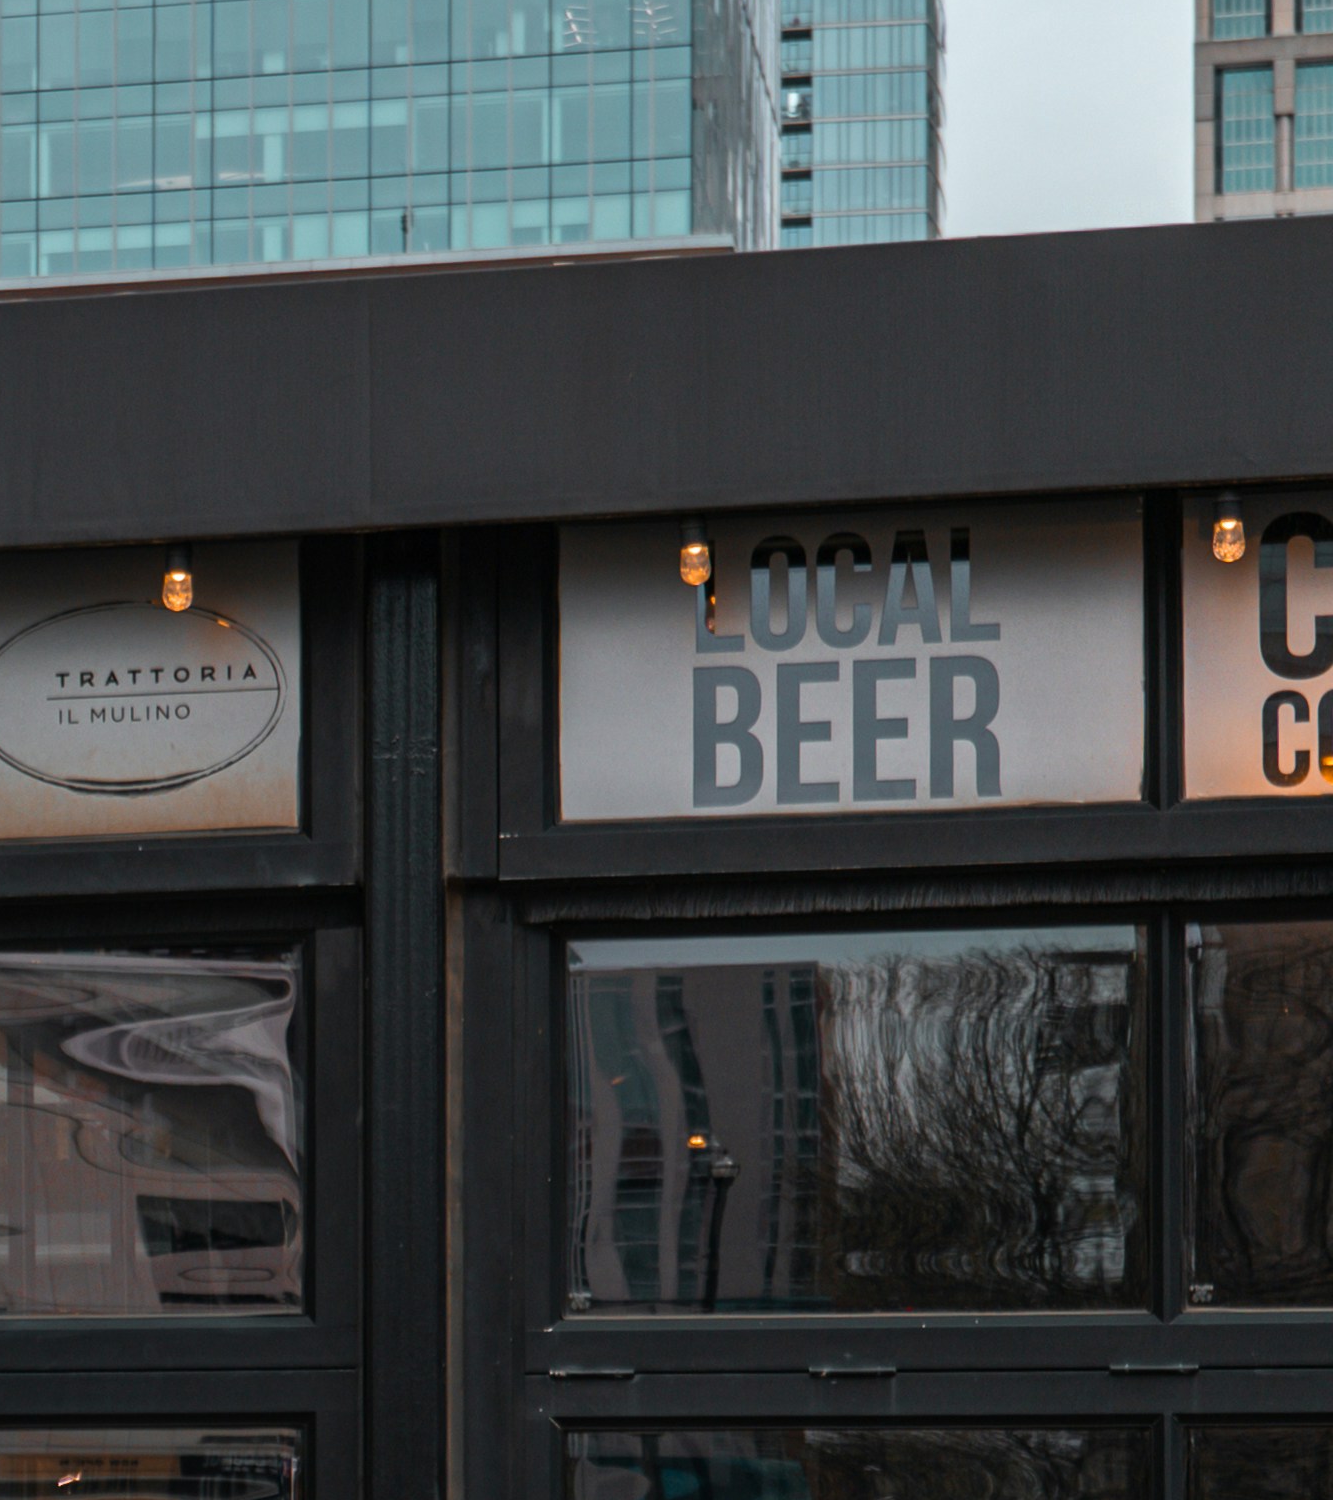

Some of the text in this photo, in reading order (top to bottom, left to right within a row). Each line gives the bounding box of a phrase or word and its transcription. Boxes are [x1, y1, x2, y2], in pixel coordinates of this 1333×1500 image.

[696, 527, 1000, 654] LOCAL
[56, 664, 258, 688] TRATTORIA
[58, 704, 192, 725] IL MULINO
[693, 655, 1002, 808] BEER
